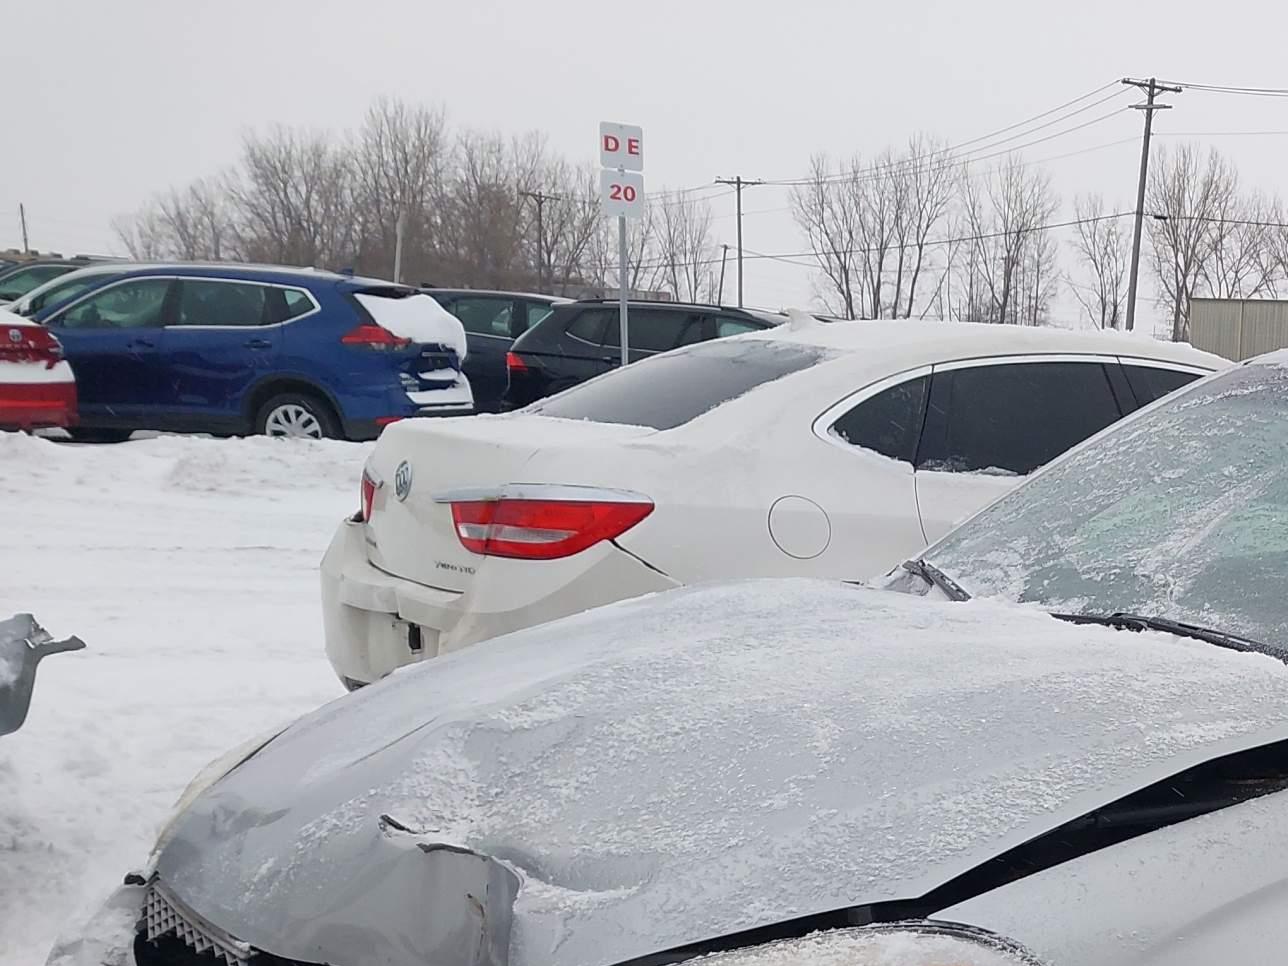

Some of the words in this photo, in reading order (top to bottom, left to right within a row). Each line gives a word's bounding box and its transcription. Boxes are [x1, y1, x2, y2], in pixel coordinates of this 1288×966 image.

[604, 135, 620, 152] D
[628, 138, 640, 156] E
[609, 184, 636, 202] 20
